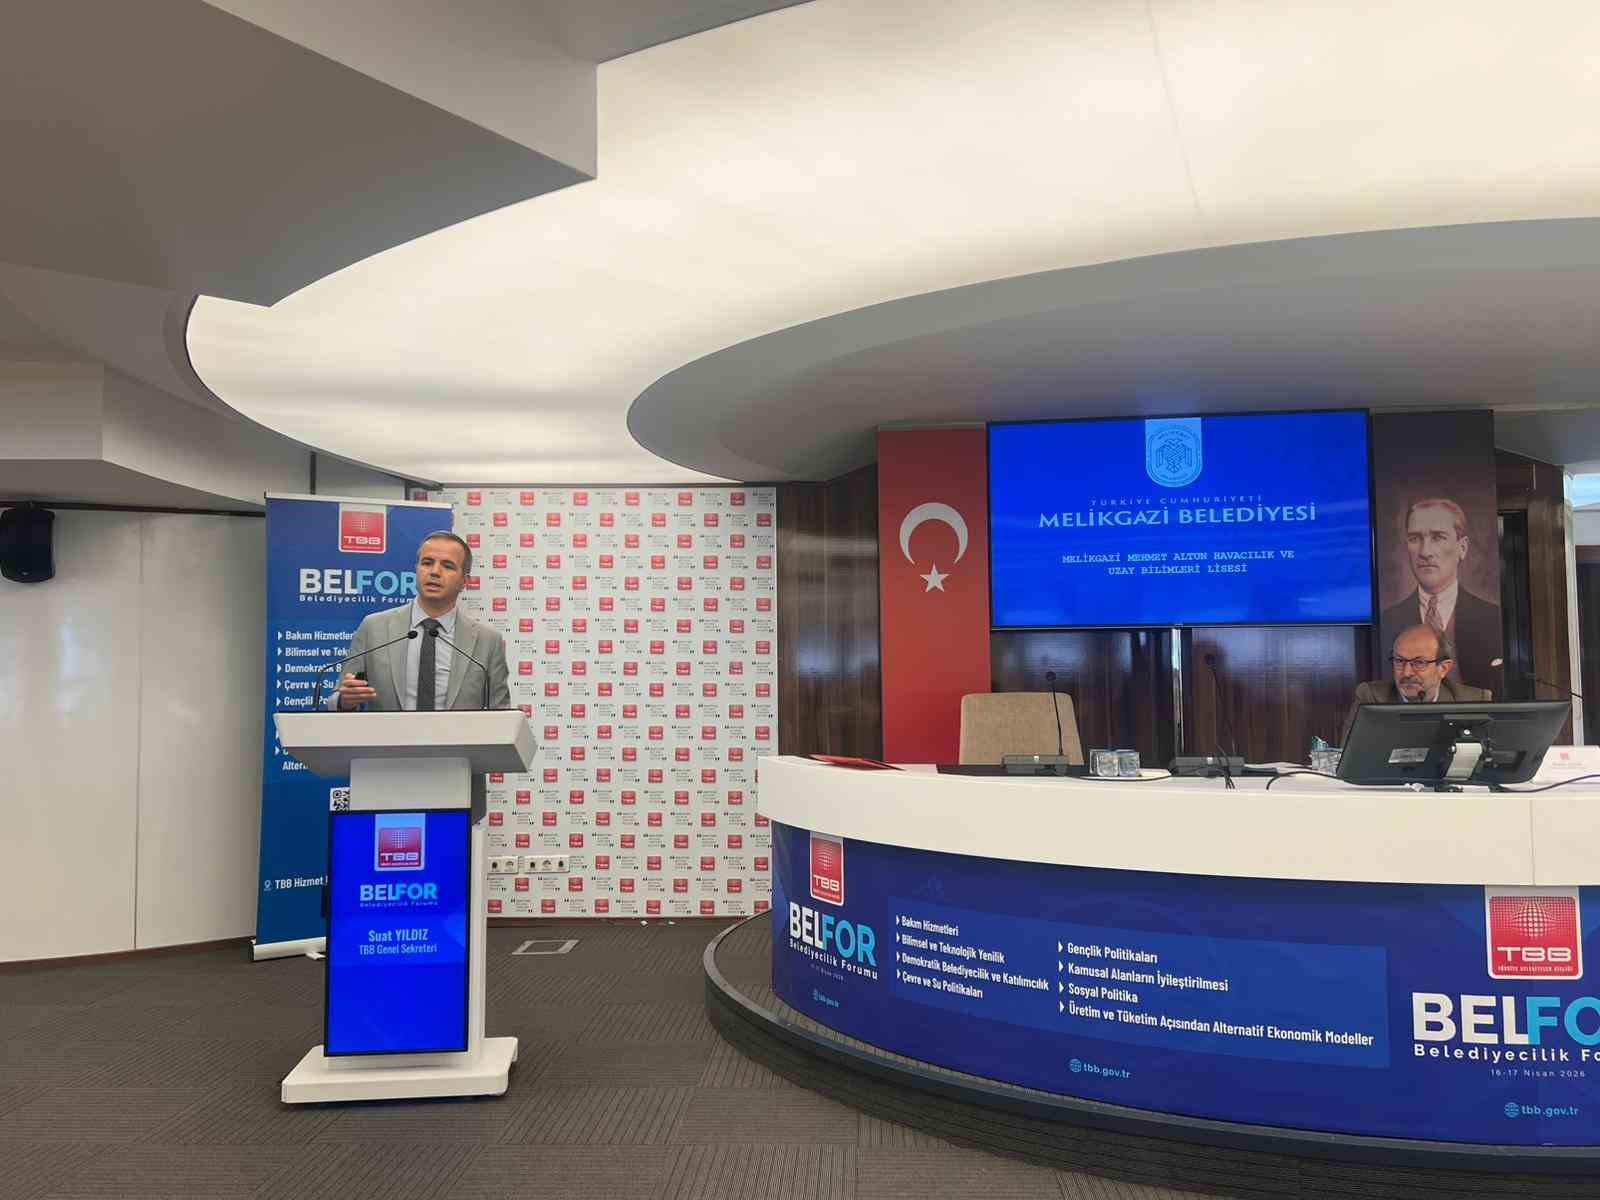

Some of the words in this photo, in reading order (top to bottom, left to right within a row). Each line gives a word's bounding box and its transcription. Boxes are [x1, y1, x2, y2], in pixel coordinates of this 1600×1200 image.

[1039, 507, 1169, 528] MELİKGAZİ
[1179, 502, 1317, 524] BELEDİYESİ
[343, 535, 382, 545] TBB
[1127, 553, 1168, 562] MEHMET
[1213, 551, 1274, 560] HAVACILIK
[1280, 551, 1295, 559] VE
[1108, 566, 1135, 575] UZAY
[1207, 563, 1249, 573] LİSESİ
[300, 568, 418, 596] BELFOR
[299, 594, 376, 603] Belediyecilik
[285, 631, 312, 640] Bakım
[314, 631, 353, 640] Hizmetler
[285, 647, 319, 656] Bilimsel
[284, 680, 308, 691] Çevre
[323, 680, 334, 689] Su
[380, 852, 419, 861] TBB
[275, 879, 292, 889] TBB
[294, 876, 323, 888] Hizmet
[813, 874, 840, 892] TBB
[360, 883, 438, 901] BELFOR
[789, 901, 877, 967] BELFOR
[901, 915, 922, 930] Bakım
[923, 920, 959, 936] Hizmetleri
[368, 930, 392, 942] Suat
[395, 929, 429, 941] YILDIZ
[360, 945, 375, 955] TBB
[377, 944, 399, 955] Genel
[401, 943, 438, 954] Sekreteri
[902, 934, 928, 949] Bilimsel
[929, 941, 938, 951] ve
[939, 942, 976, 960] Teknolojik
[978, 949, 1005, 964] Yenilik
[1067, 942, 1102, 958] Gençlik
[1104, 946, 1158, 963] Politikaları
[1497, 947, 1572, 962] TBB
[790, 938, 838, 967] Belediyecilik
[841, 959, 878, 980] Forumu
[902, 952, 941, 970] Demokratik
[942, 961, 989, 980] Belediyecilik
[991, 973, 1001, 982] ve
[1003, 972, 1049, 991] Katılımcılık
[1068, 962, 1109, 979] Kamusal
[1111, 968, 1155, 985] Alanların
[1157, 970, 1229, 991] İyileştirilmesi
[902, 971, 921, 984] Çevre
[922, 977, 931, 987] ve
[932, 978, 941, 990] Su
[942, 980, 983, 999] Politikaları
[1068, 982, 1099, 999] Sosyal
[1101, 987, 1138, 1003] Politika
[1069, 1001, 1101, 1019] Üretim
[1103, 1010, 1115, 1021] ve
[1116, 1010, 1158, 1026] Tüketim
[1160, 1015, 1210, 1032] Açısından
[1213, 1021, 1265, 1038] Alternatif
[1267, 1026, 1322, 1043] Ekonomik
[1325, 1031, 1374, 1046] Modeller
[1412, 992, 1600, 1046] BELFO
[1414, 1043, 1569, 1064] Belediyecilik
[1083, 1062, 1130, 1079] tbb.gov.tr
[1524, 1069, 1555, 1077] Nisan
[1521, 1105, 1579, 1117] tbb.gov.tr
